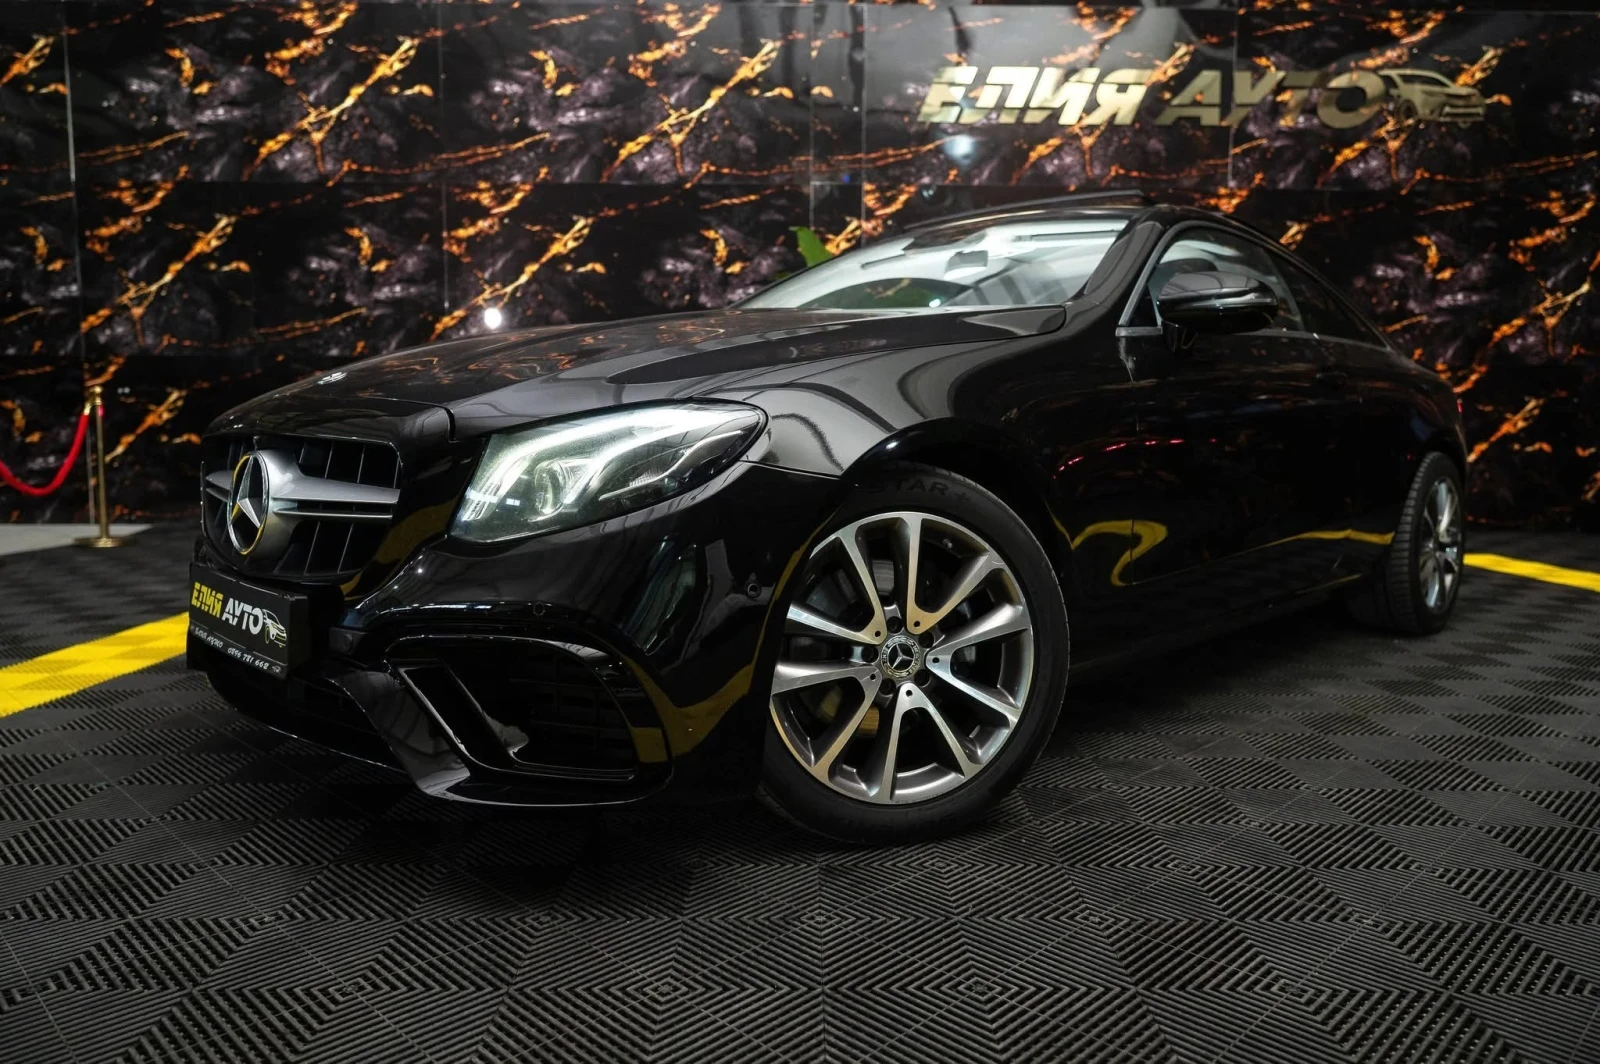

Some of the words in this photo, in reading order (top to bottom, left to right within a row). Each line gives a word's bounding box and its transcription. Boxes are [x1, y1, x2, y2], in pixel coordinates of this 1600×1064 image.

[917, 65, 1152, 126] ЕЛИЯ
[1154, 69, 1386, 129] АУТО
[191, 581, 224, 618] ЕЛИЯ
[221, 597, 264, 634] АУТО
